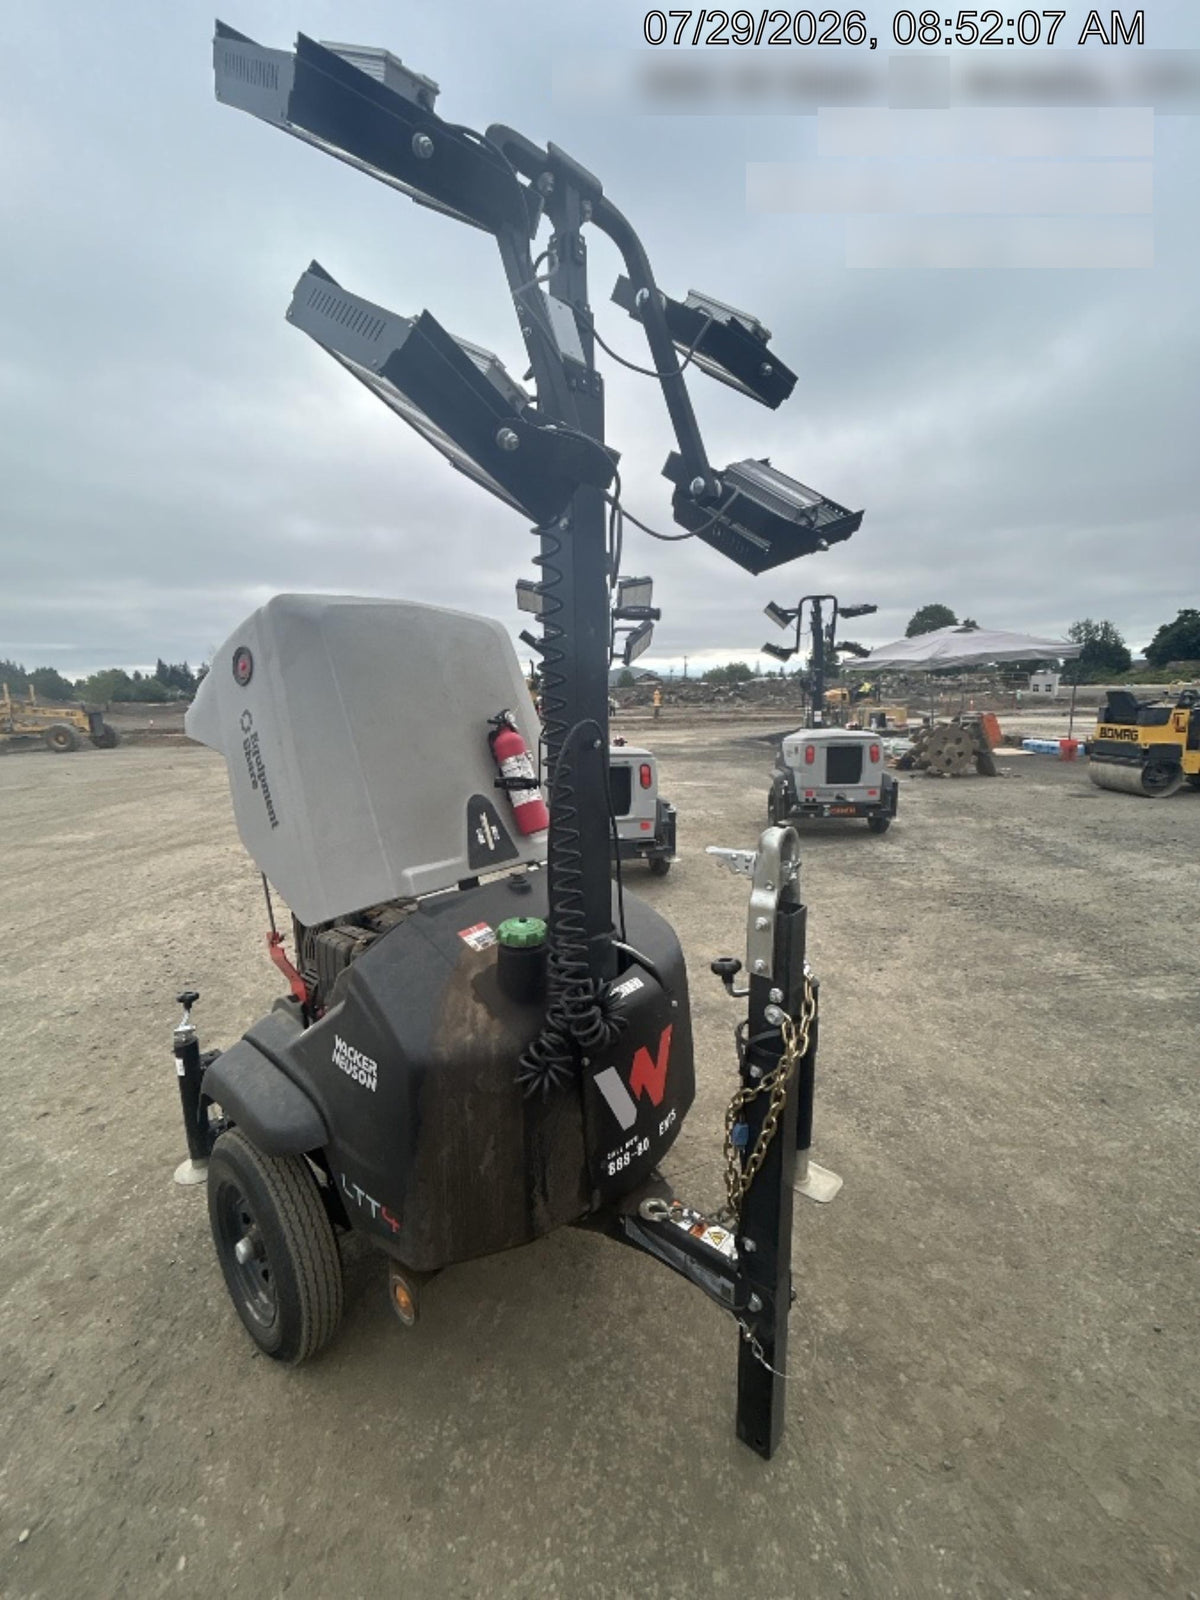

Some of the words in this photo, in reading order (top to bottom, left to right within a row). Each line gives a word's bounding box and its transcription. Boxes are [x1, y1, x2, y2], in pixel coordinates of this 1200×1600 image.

[1099, 726, 1139, 741] BOMAG
[249, 731, 280, 831] Equipment
[331, 1048, 378, 1092] NEUSON
[334, 1034, 378, 1077] WACKER
[341, 1173, 400, 1233] LTT4
